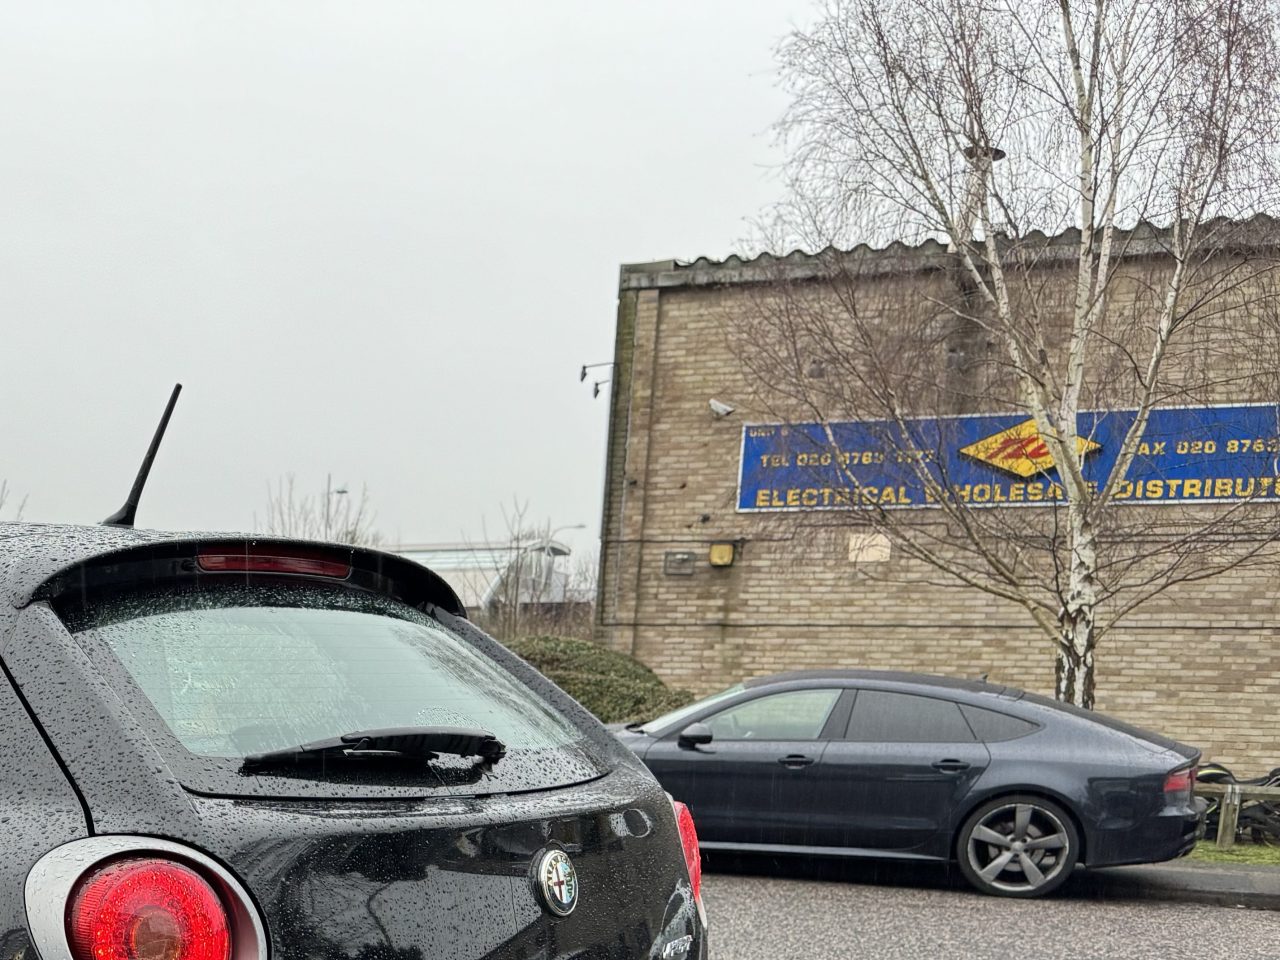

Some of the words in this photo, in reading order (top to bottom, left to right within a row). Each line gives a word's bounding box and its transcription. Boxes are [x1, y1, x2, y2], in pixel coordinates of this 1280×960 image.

[1138, 441, 1166, 455] AX
[1176, 440, 1216, 454] 020
[756, 486, 912, 506] ELECTRICAL
[925, 482, 1098, 504] WHOLESAE
